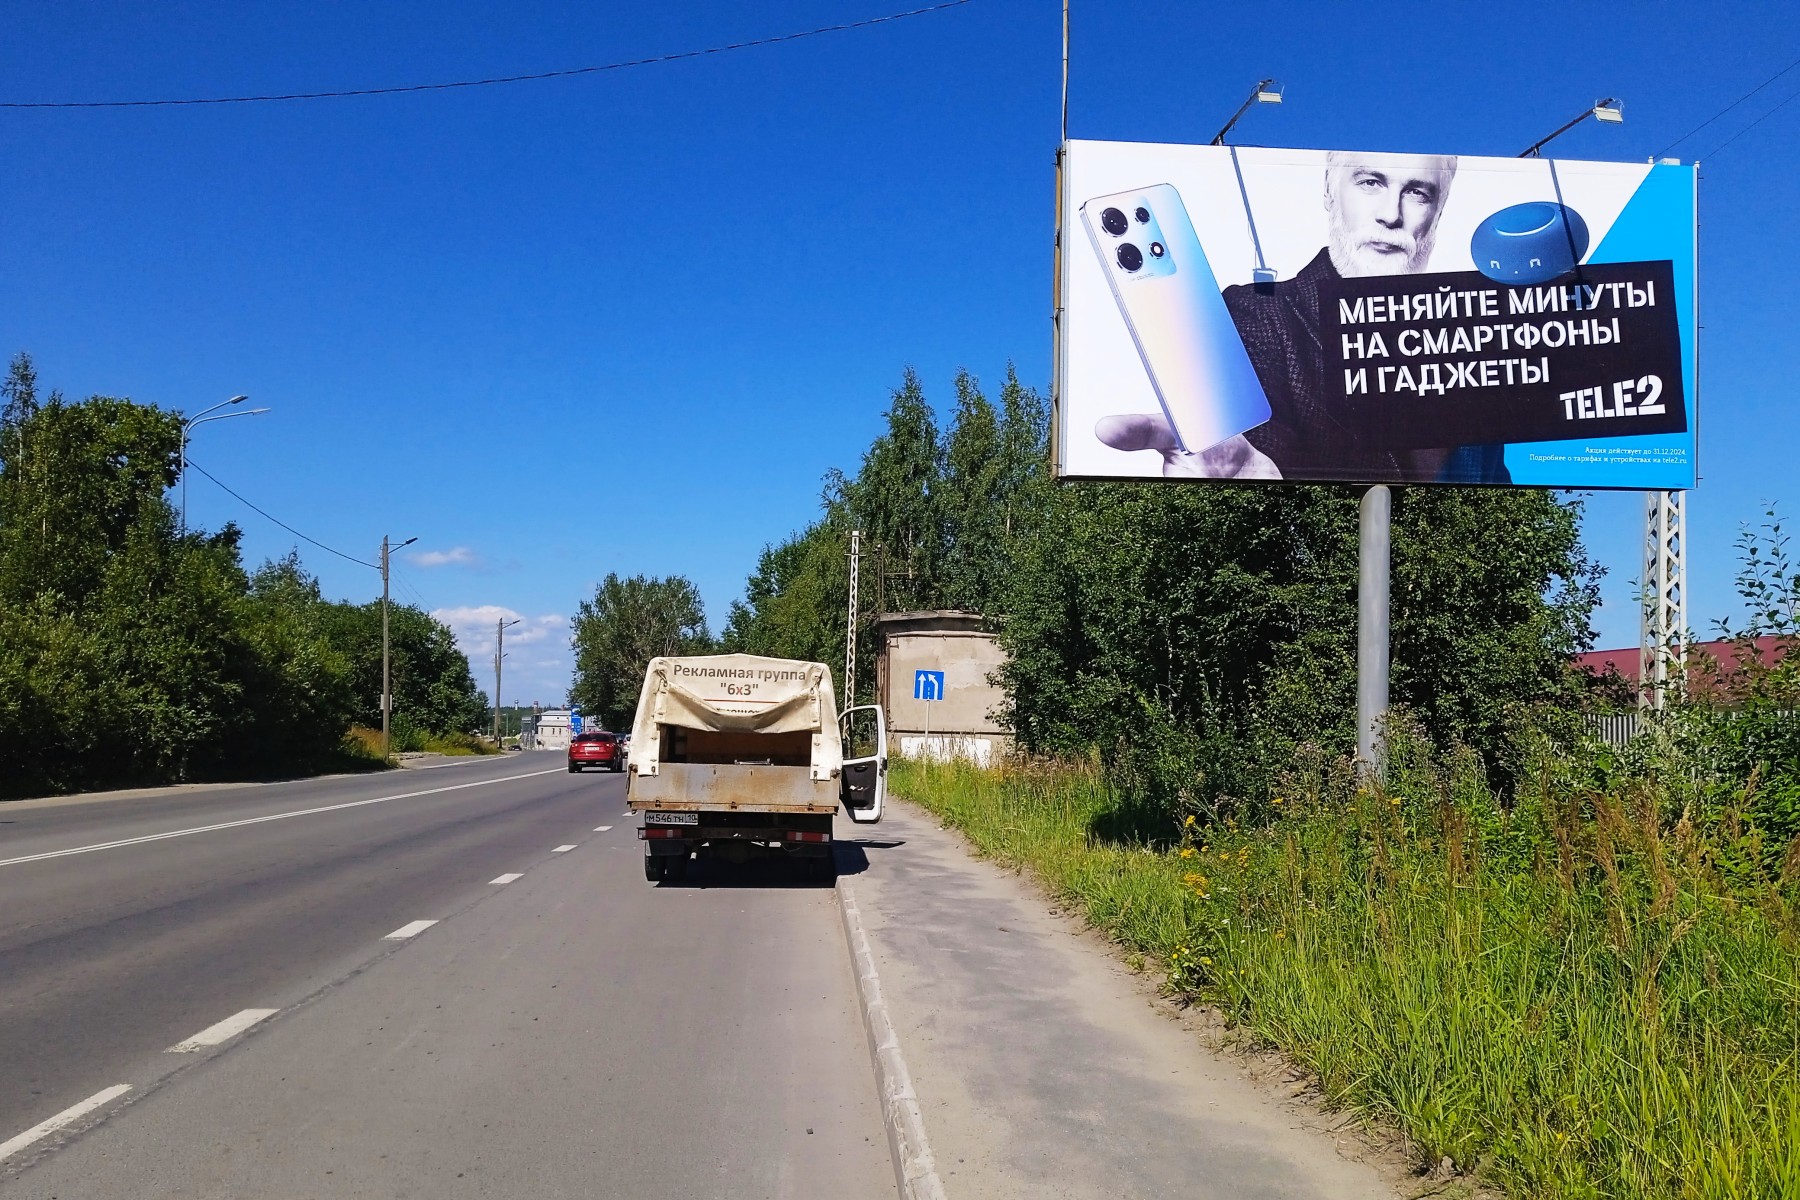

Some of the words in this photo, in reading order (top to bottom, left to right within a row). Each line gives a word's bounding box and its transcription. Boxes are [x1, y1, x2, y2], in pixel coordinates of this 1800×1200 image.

[1339, 286, 1499, 325] МЕНЯЙТЕ
[1508, 281, 1656, 315] МИНУТЫ
[1342, 332, 1390, 360] НА
[1398, 318, 1621, 357] СМАРТФОНЫ
[1344, 367, 1368, 395] И
[1378, 356, 1550, 397] ГАДЖЕТЫ
[1559, 374, 1666, 421] TELE2
[1529, 454, 1566, 463] Подробнее
[1574, 456, 1602, 464] тарифах
[1610, 456, 1651, 465] устройствах
[1585, 447, 1607, 455] Акция
[1608, 448, 1641, 456] действует
[674, 664, 754, 679] Рекламная
[758, 669, 806, 682] группа
